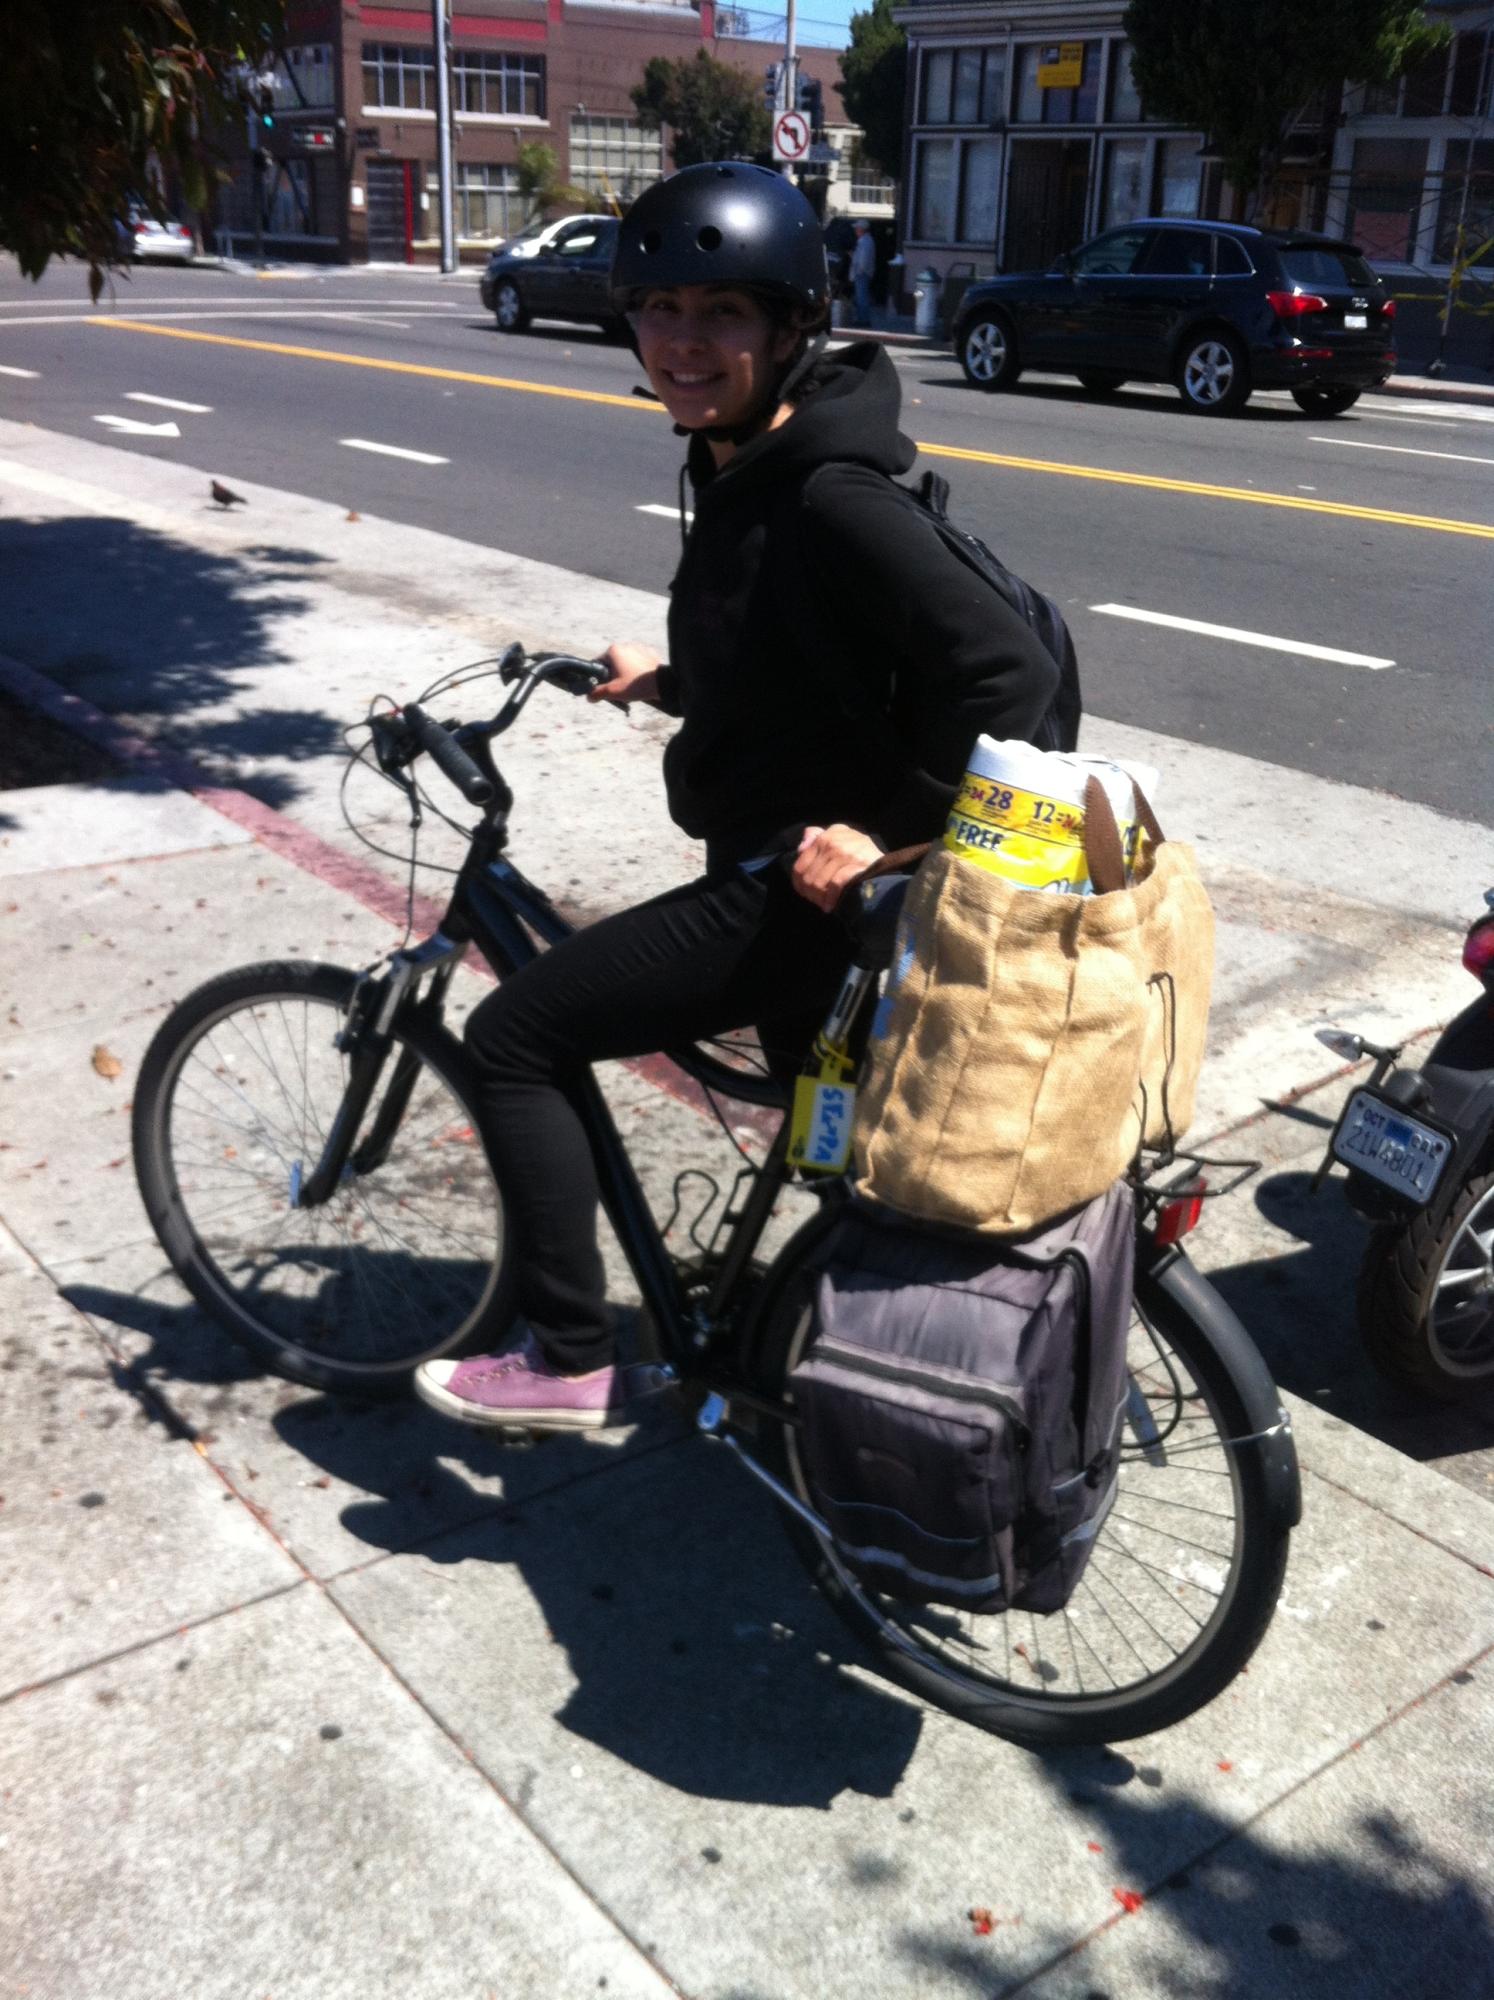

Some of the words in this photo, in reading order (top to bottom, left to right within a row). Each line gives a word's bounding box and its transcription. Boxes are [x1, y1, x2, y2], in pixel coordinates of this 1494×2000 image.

[985, 785, 1014, 810] 28
[1033, 800, 1056, 823] 12
[956, 820, 1005, 851] FREE
[1363, 1109, 1386, 1128] OCT
